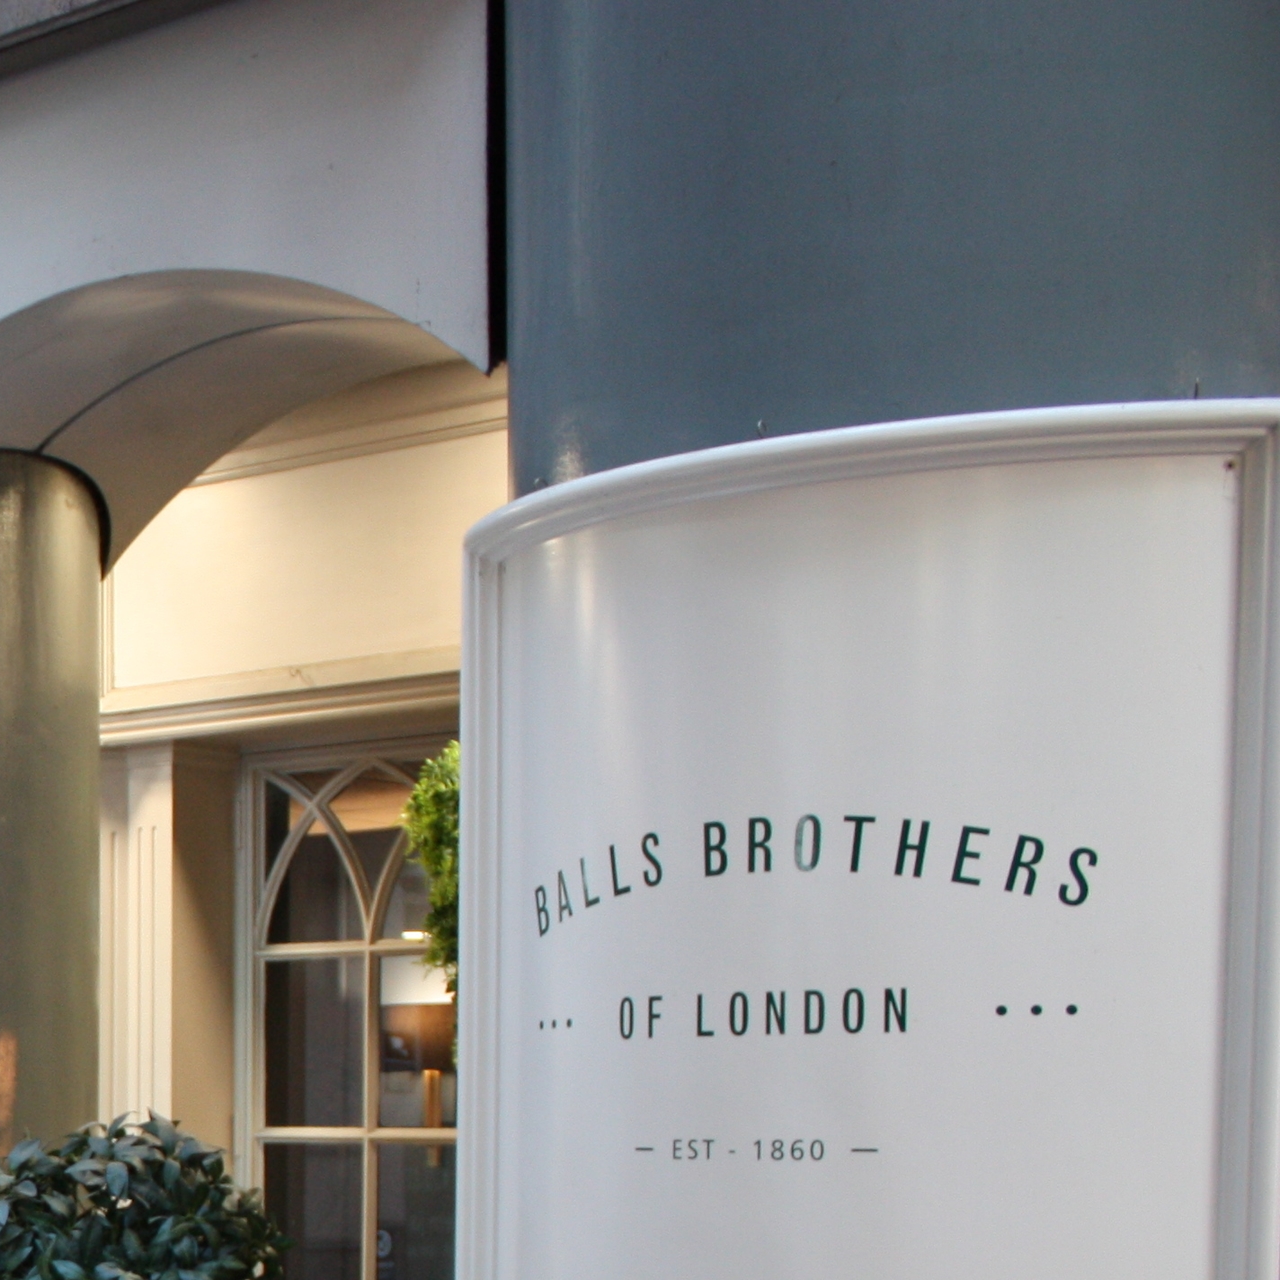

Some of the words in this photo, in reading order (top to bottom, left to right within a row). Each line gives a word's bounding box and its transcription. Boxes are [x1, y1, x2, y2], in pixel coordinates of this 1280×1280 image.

[533, 831, 664, 938] BALLS
[702, 813, 1099, 908] BROTHERS
[618, 994, 664, 1041] OF
[695, 986, 909, 1038] LONDON
[671, 1138, 716, 1162] EST
[752, 1138, 826, 1162] 1860
